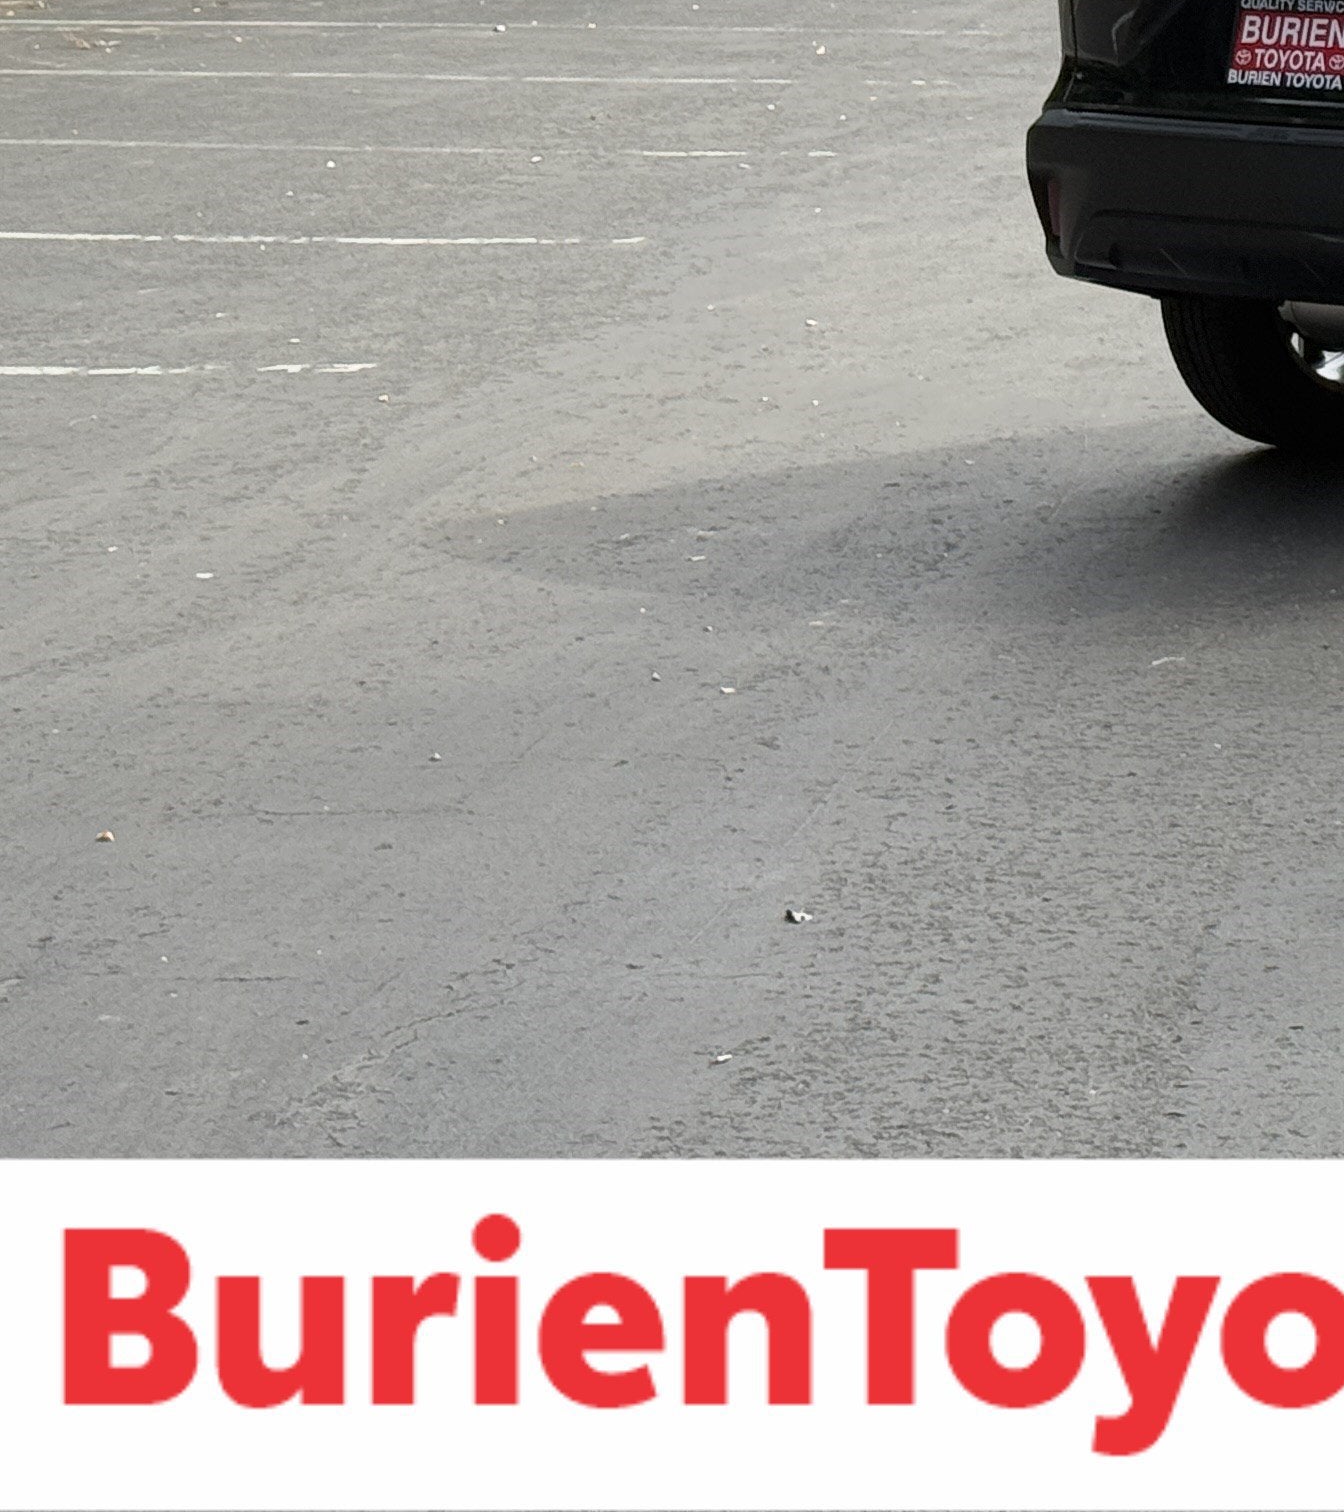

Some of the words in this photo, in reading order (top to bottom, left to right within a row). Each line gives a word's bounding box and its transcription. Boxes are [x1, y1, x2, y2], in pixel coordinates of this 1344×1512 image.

[1254, 49, 1325, 72] TOYOTA
[1227, 69, 1281, 86] BURIEN
[1286, 73, 1342, 90] TOYOTA
